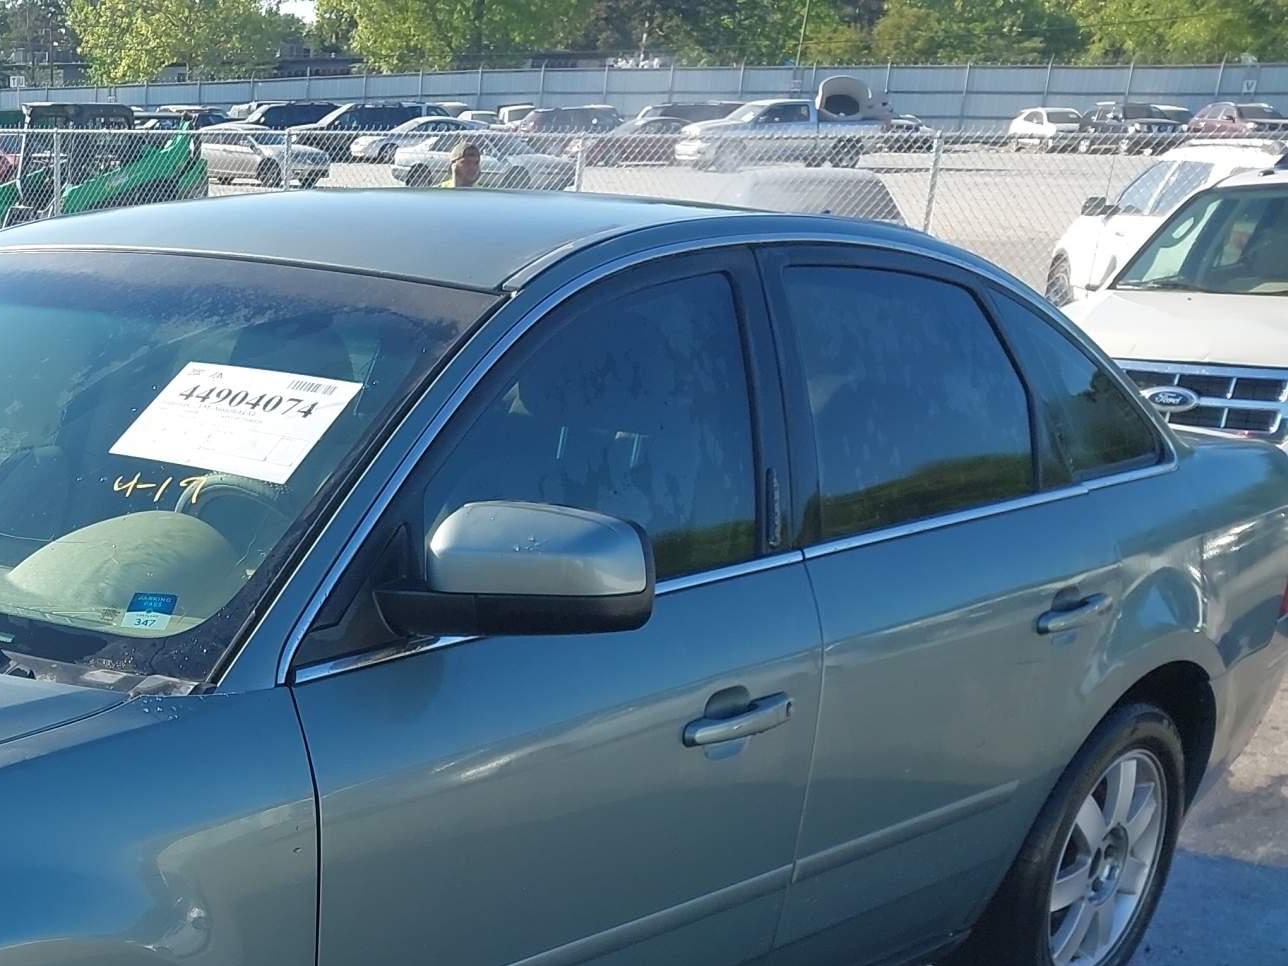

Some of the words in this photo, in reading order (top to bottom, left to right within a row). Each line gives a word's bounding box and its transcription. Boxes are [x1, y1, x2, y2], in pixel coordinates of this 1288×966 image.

[179, 384, 319, 418] 44904074
[1154, 392, 1183, 405] Ford
[134, 618, 156, 627] 347
